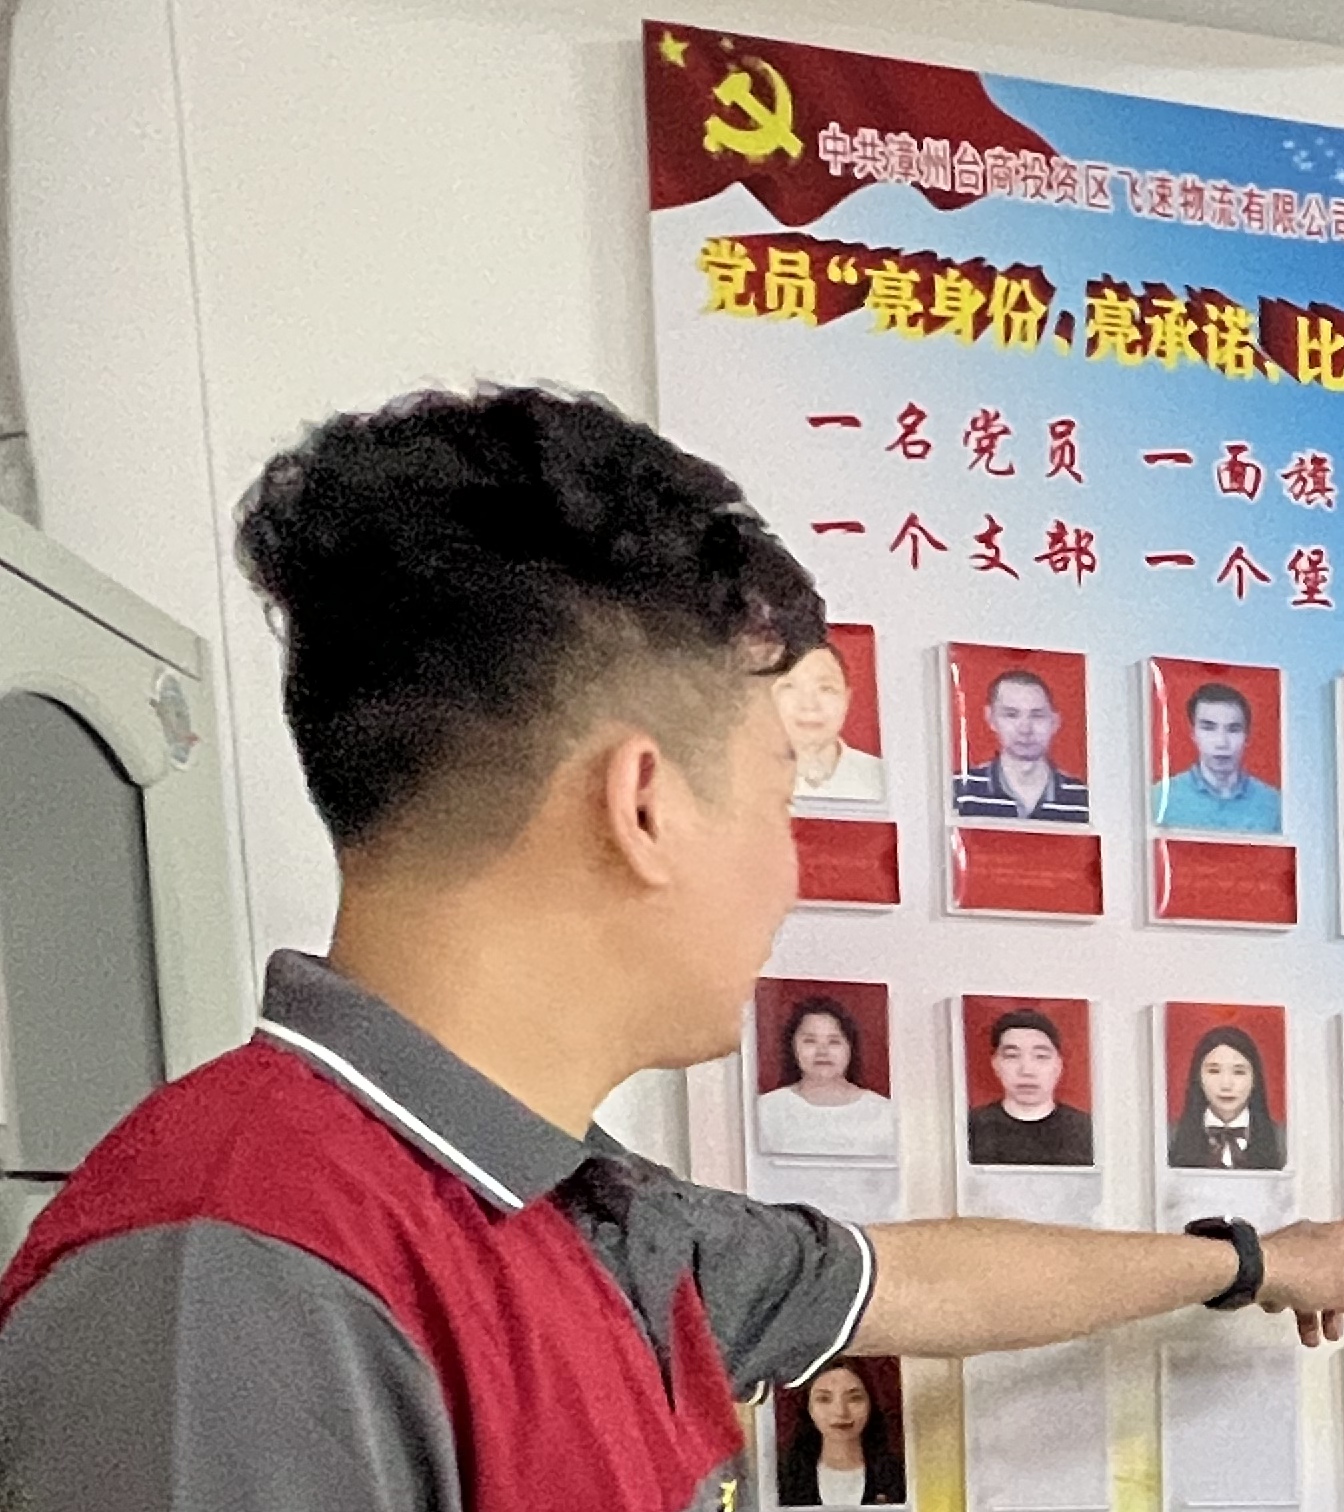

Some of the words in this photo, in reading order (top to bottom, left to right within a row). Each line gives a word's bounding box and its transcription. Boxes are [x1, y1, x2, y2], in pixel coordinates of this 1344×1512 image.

[808, 401, 1086, 484] 一名党员
[811, 512, 1098, 585] 一个支部
